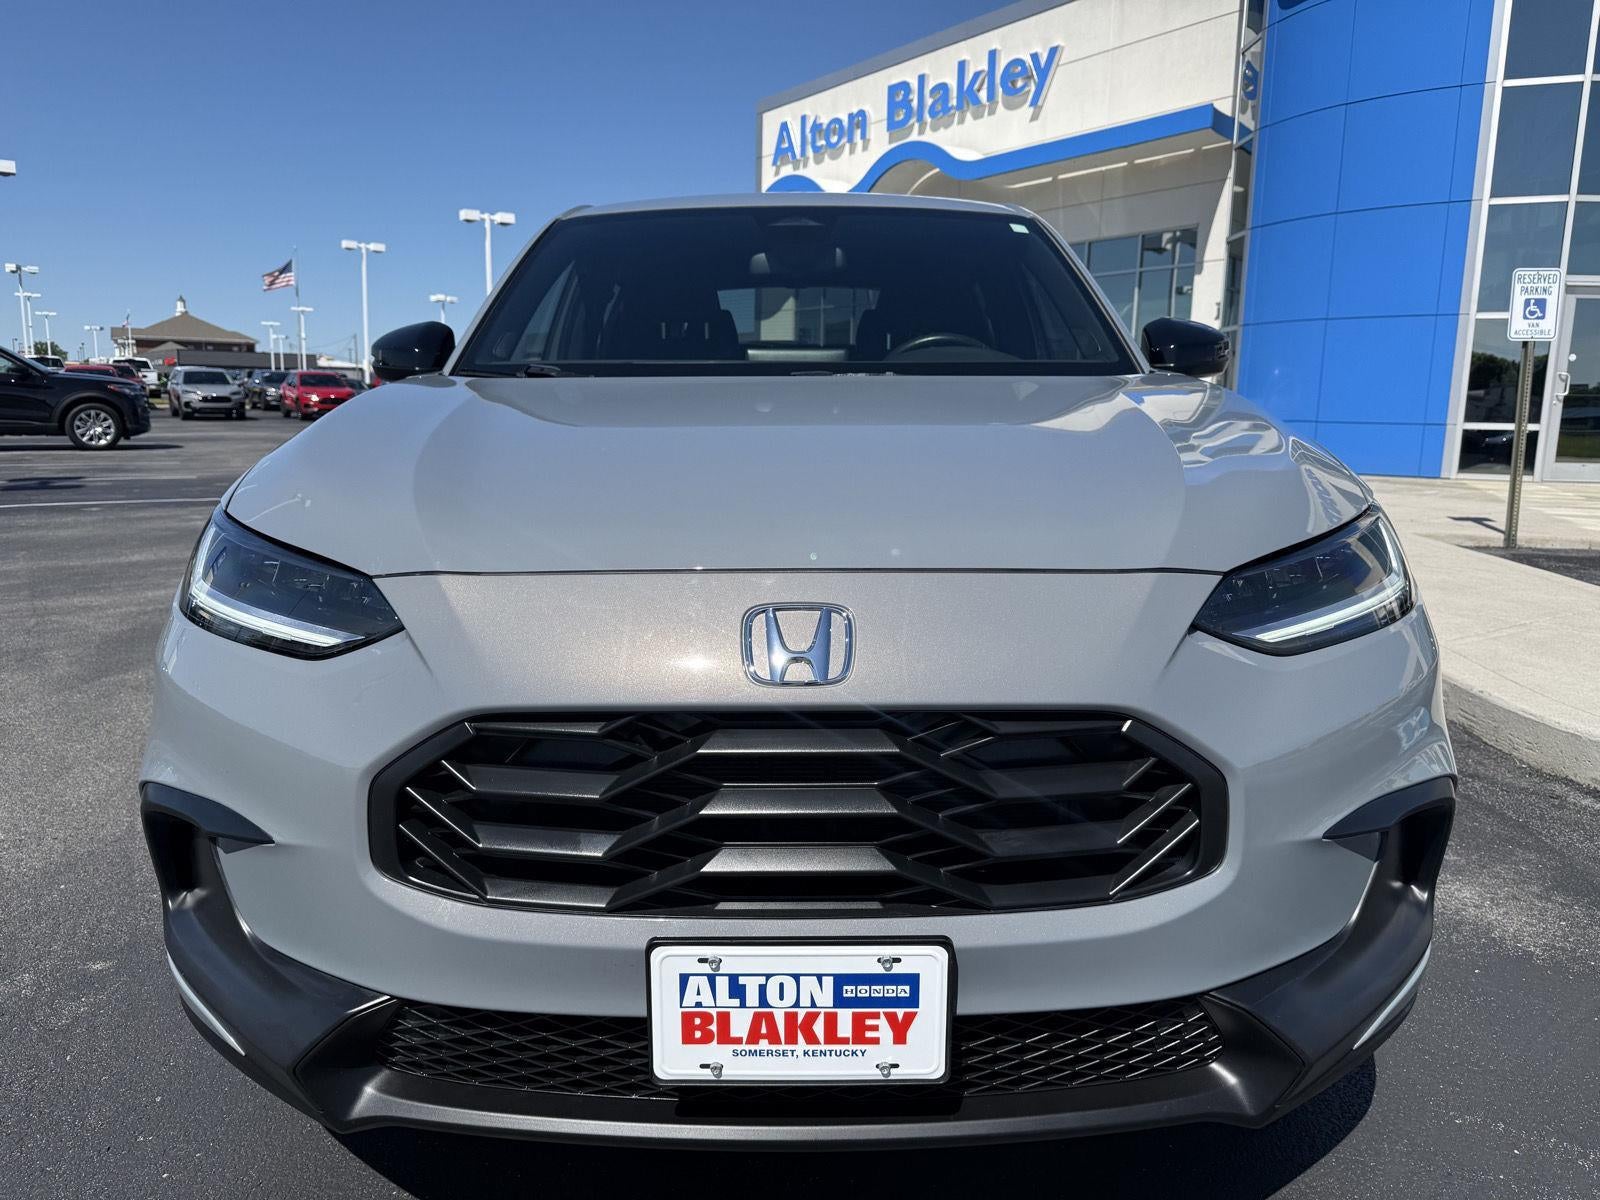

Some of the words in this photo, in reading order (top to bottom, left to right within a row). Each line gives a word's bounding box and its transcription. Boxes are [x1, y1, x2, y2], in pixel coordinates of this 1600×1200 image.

[772, 106, 867, 166] Alton
[886, 45, 1062, 132] Blakley
[1517, 273, 1558, 284] RESERVED
[1520, 286, 1553, 296] PARKING
[681, 975, 834, 1008] ALTON
[844, 986, 910, 996] HONDA
[681, 1011, 918, 1045] BLAKLEY
[732, 1048, 799, 1059] SOMERSET,
[803, 1048, 867, 1058] KENTUCKY
